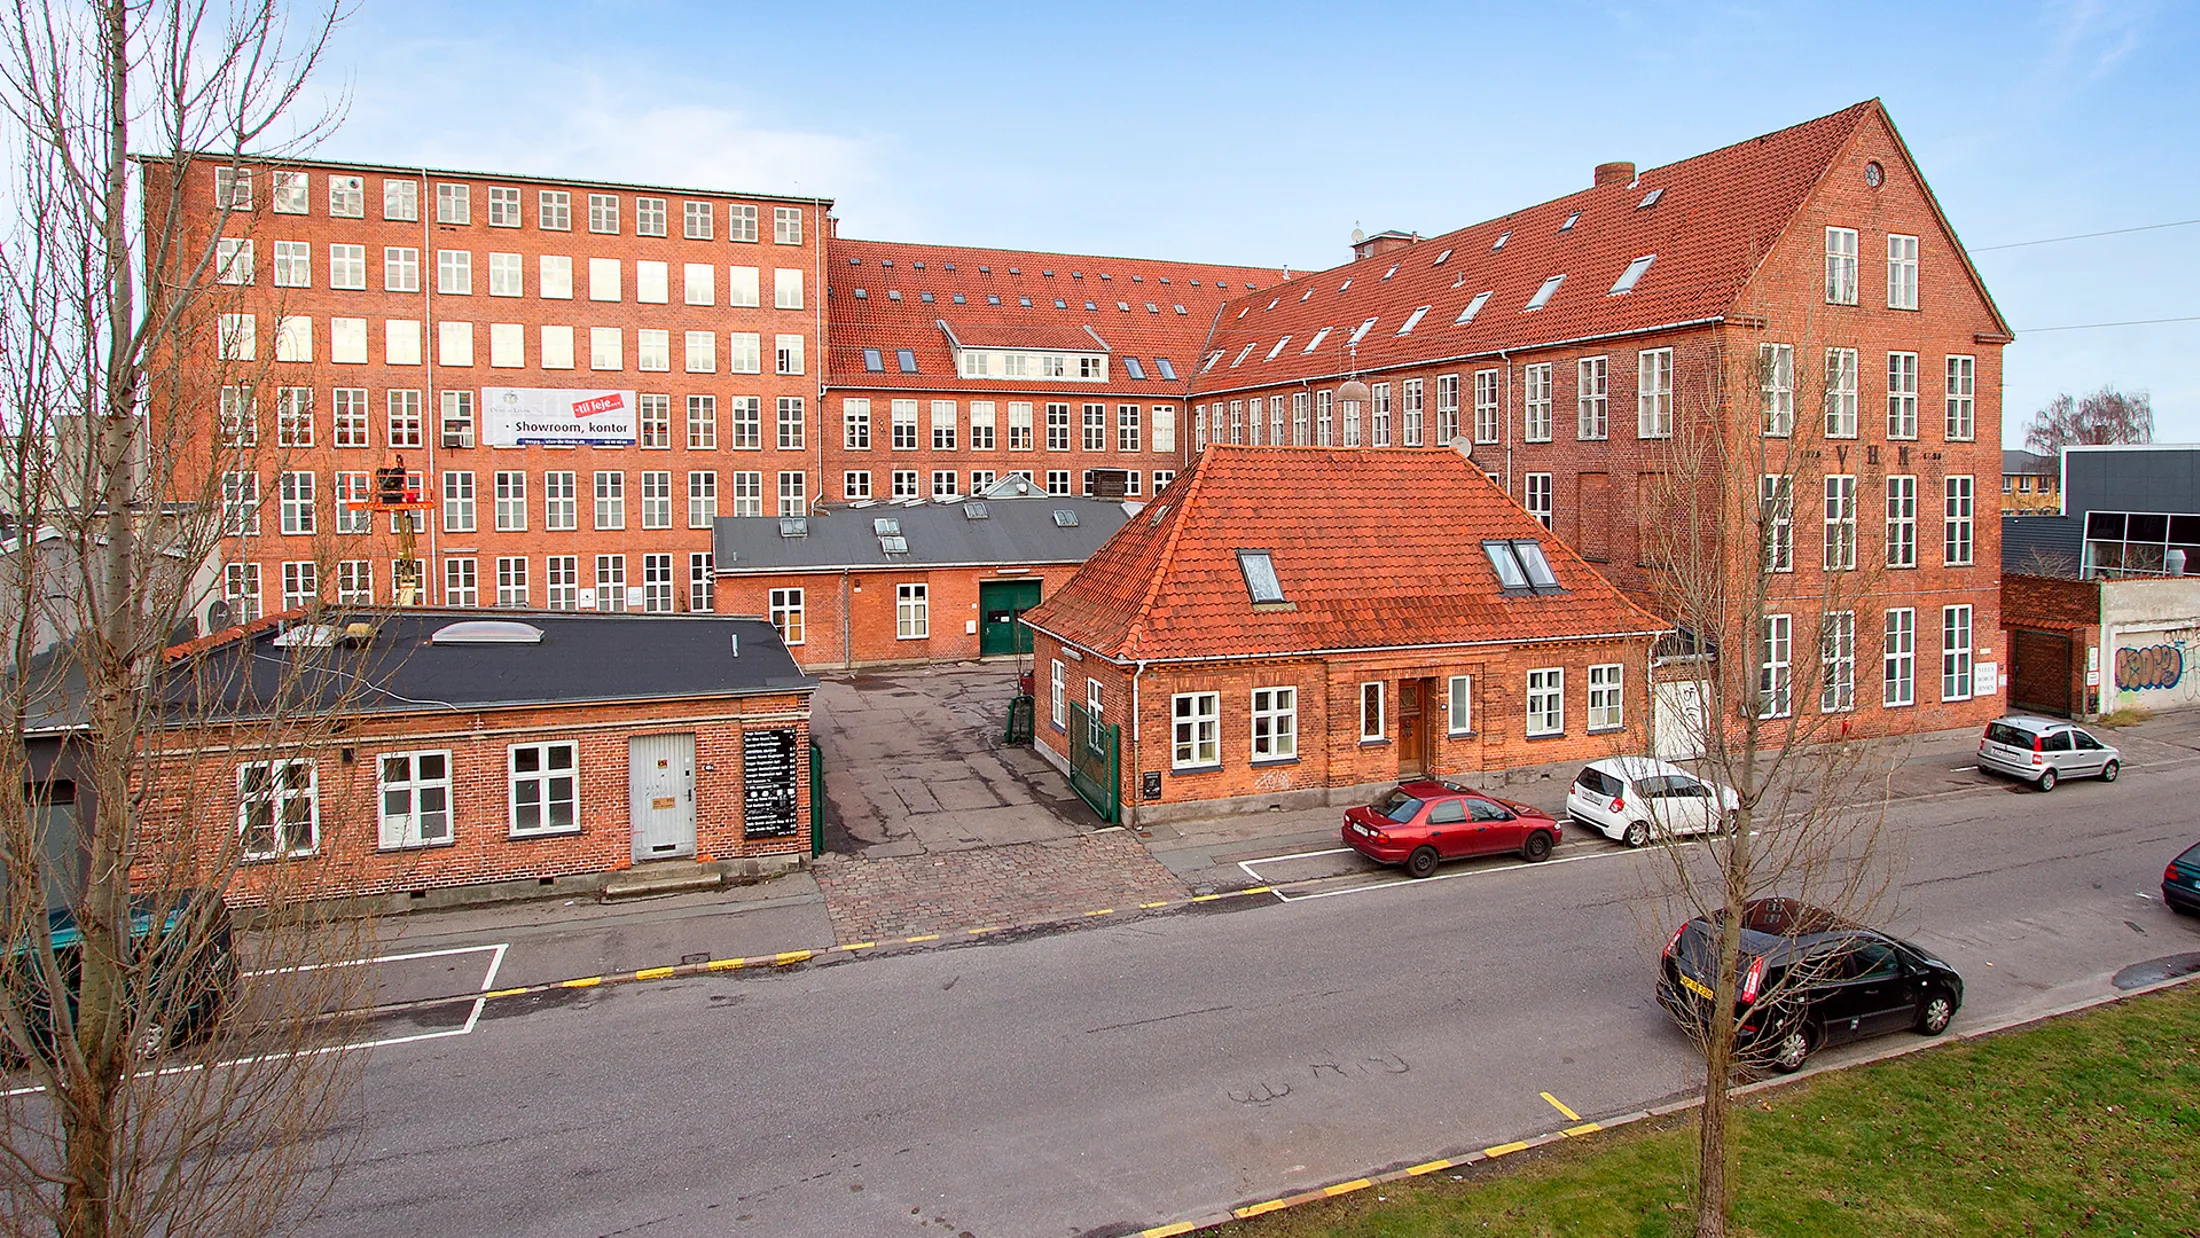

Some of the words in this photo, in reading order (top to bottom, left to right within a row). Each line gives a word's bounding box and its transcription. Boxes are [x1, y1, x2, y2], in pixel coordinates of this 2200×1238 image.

[516, 421, 584, 434] Showroom,
[589, 422, 627, 432] kontor
[1867, 445, 1879, 464] H
